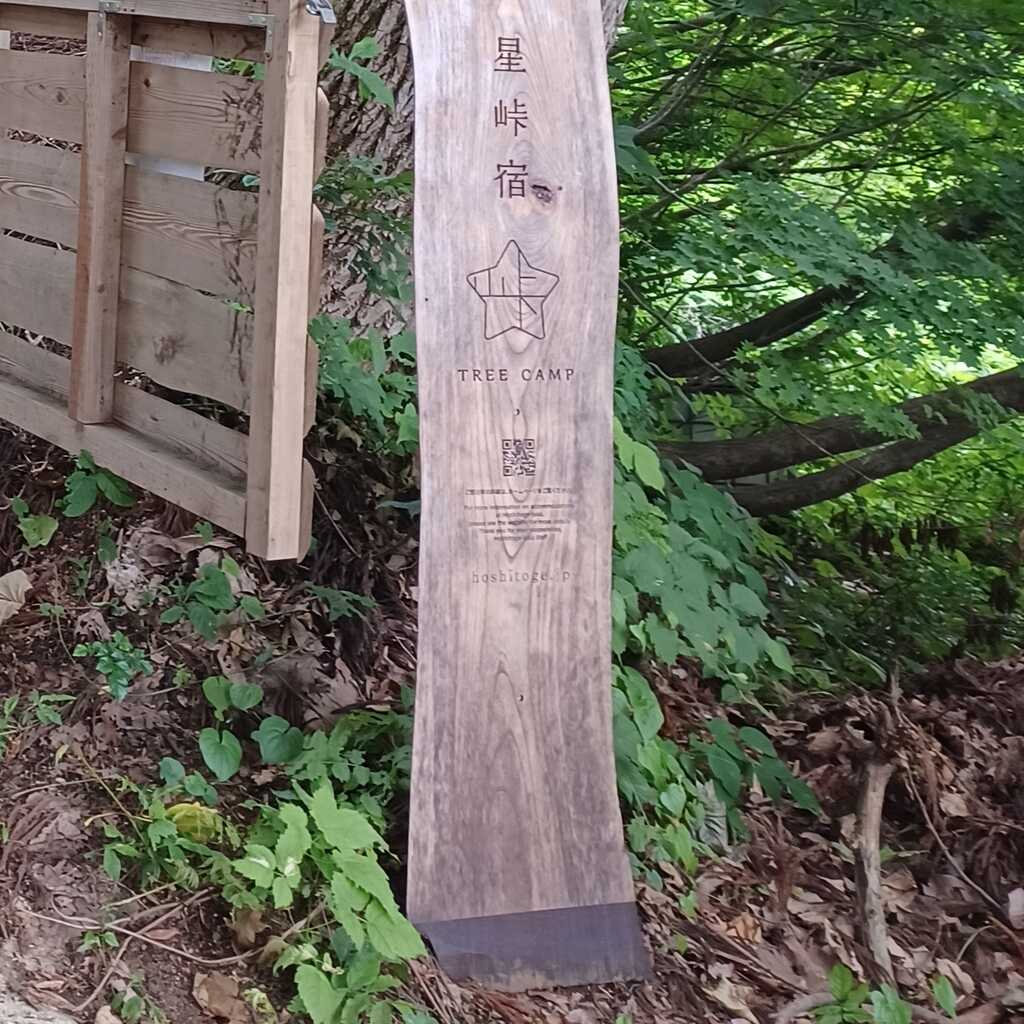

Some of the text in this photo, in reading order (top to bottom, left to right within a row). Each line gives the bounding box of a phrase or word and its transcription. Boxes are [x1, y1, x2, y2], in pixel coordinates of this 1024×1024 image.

[493, 36, 528, 199] 星峠宿
[457, 368, 575, 382] TREE CAMP
